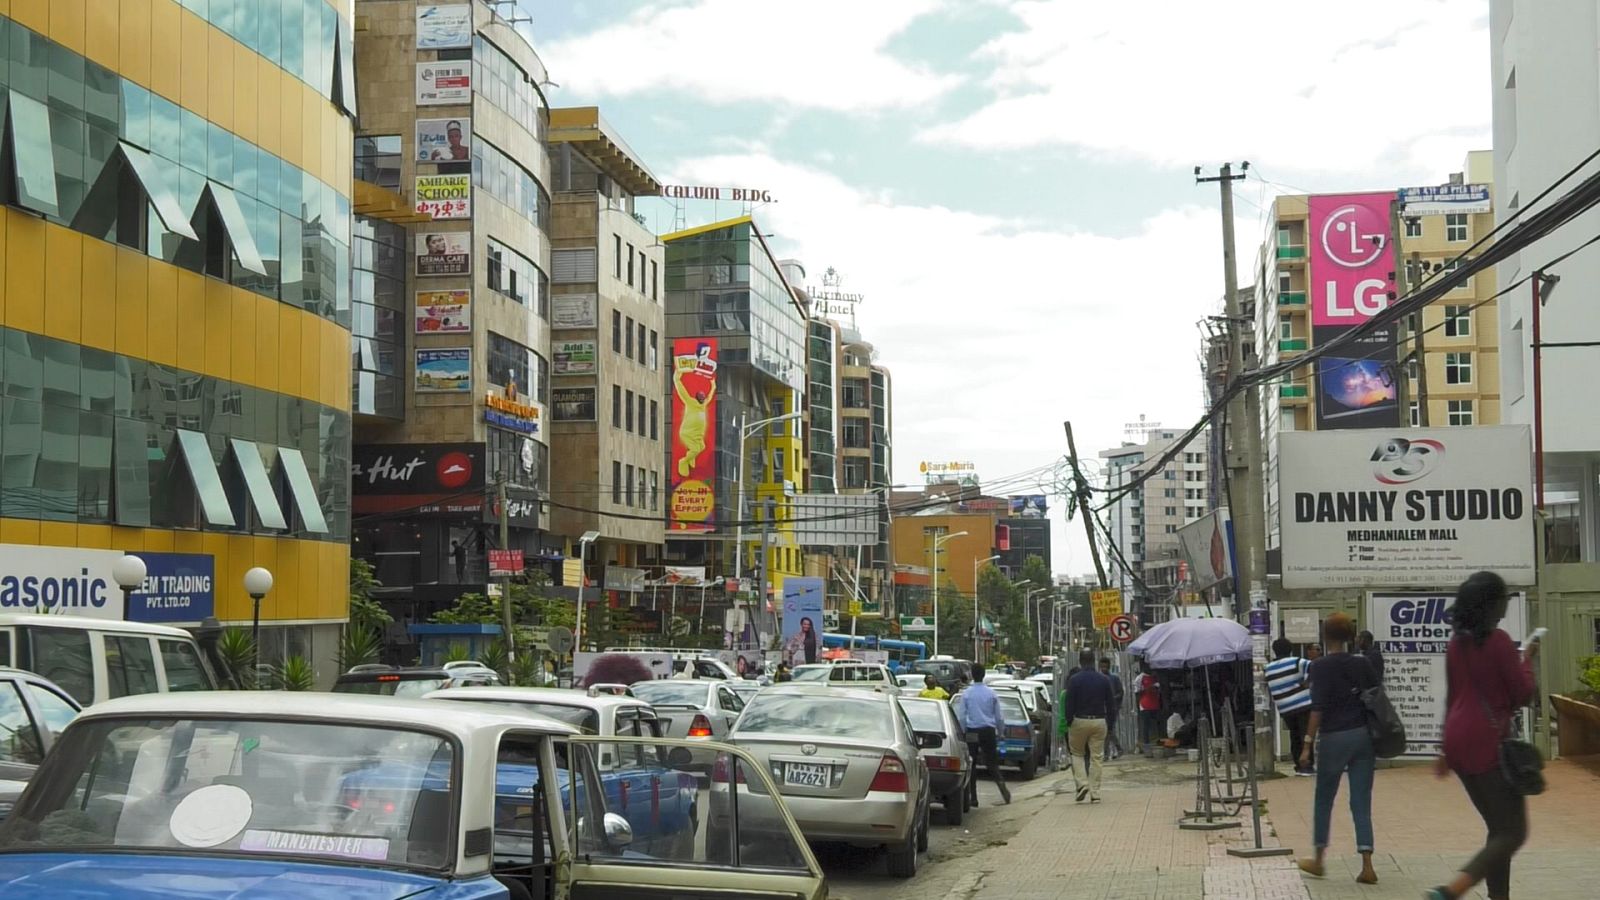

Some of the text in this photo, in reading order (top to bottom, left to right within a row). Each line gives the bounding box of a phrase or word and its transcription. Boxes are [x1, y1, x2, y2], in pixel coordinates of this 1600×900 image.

[418, 177, 468, 186] AMHARIC
[417, 188, 468, 199] SCHOOL
[732, 188, 778, 203] BLDG.
[446, 255, 465, 263] CARE
[806, 285, 865, 305] Harmony
[1326, 279, 1387, 317] LG
[819, 300, 855, 316] Hotel
[367, 456, 427, 483] Hut
[1294, 488, 1523, 523] DANNY STUDIO
[1347, 528, 1458, 541] MEDHANIALEM MALL
[1, 568, 107, 607] asonic
[162, 575, 211, 594] TRADING
[266, 831, 362, 854] MANCHESTER
